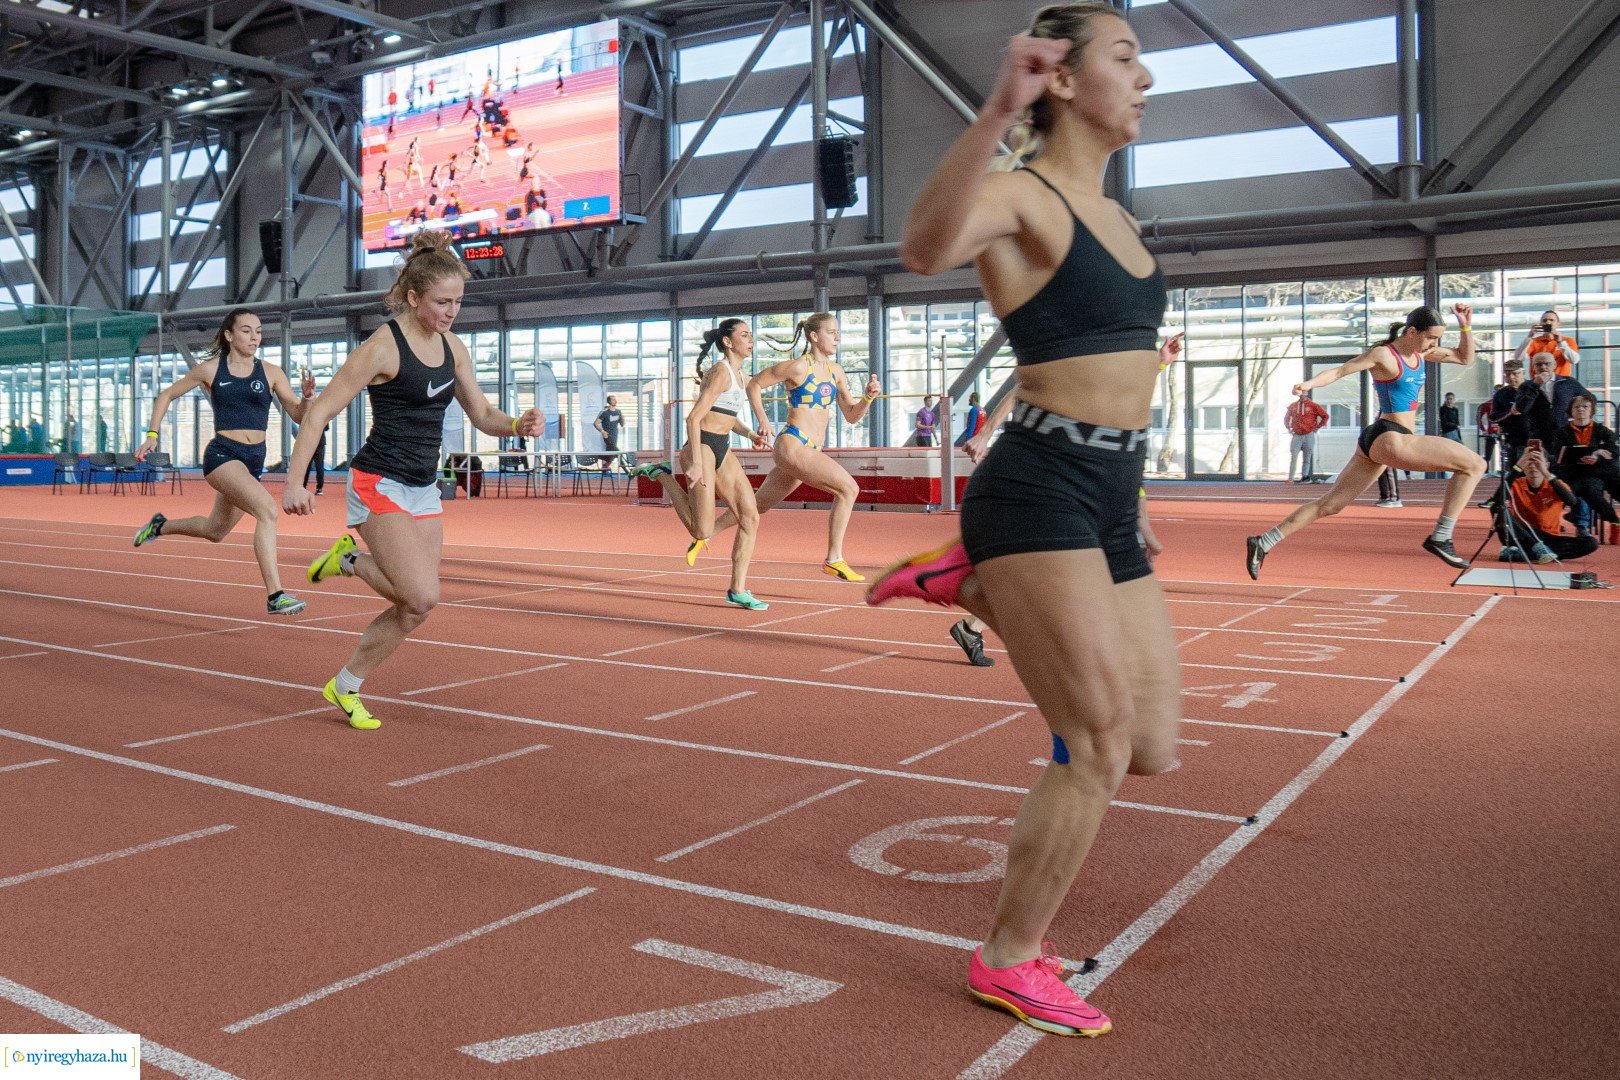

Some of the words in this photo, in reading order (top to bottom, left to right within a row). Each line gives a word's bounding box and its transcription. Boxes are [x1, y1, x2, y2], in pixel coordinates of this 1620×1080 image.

[465, 245, 504, 259] 12:23:28
[1345, 594, 1408, 607] 1
[1291, 614, 1388, 632] 2
[1235, 641, 1346, 663] 3
[1180, 681, 1279, 709] 4
[848, 815, 1016, 884] 6
[456, 937, 846, 1064] 7
